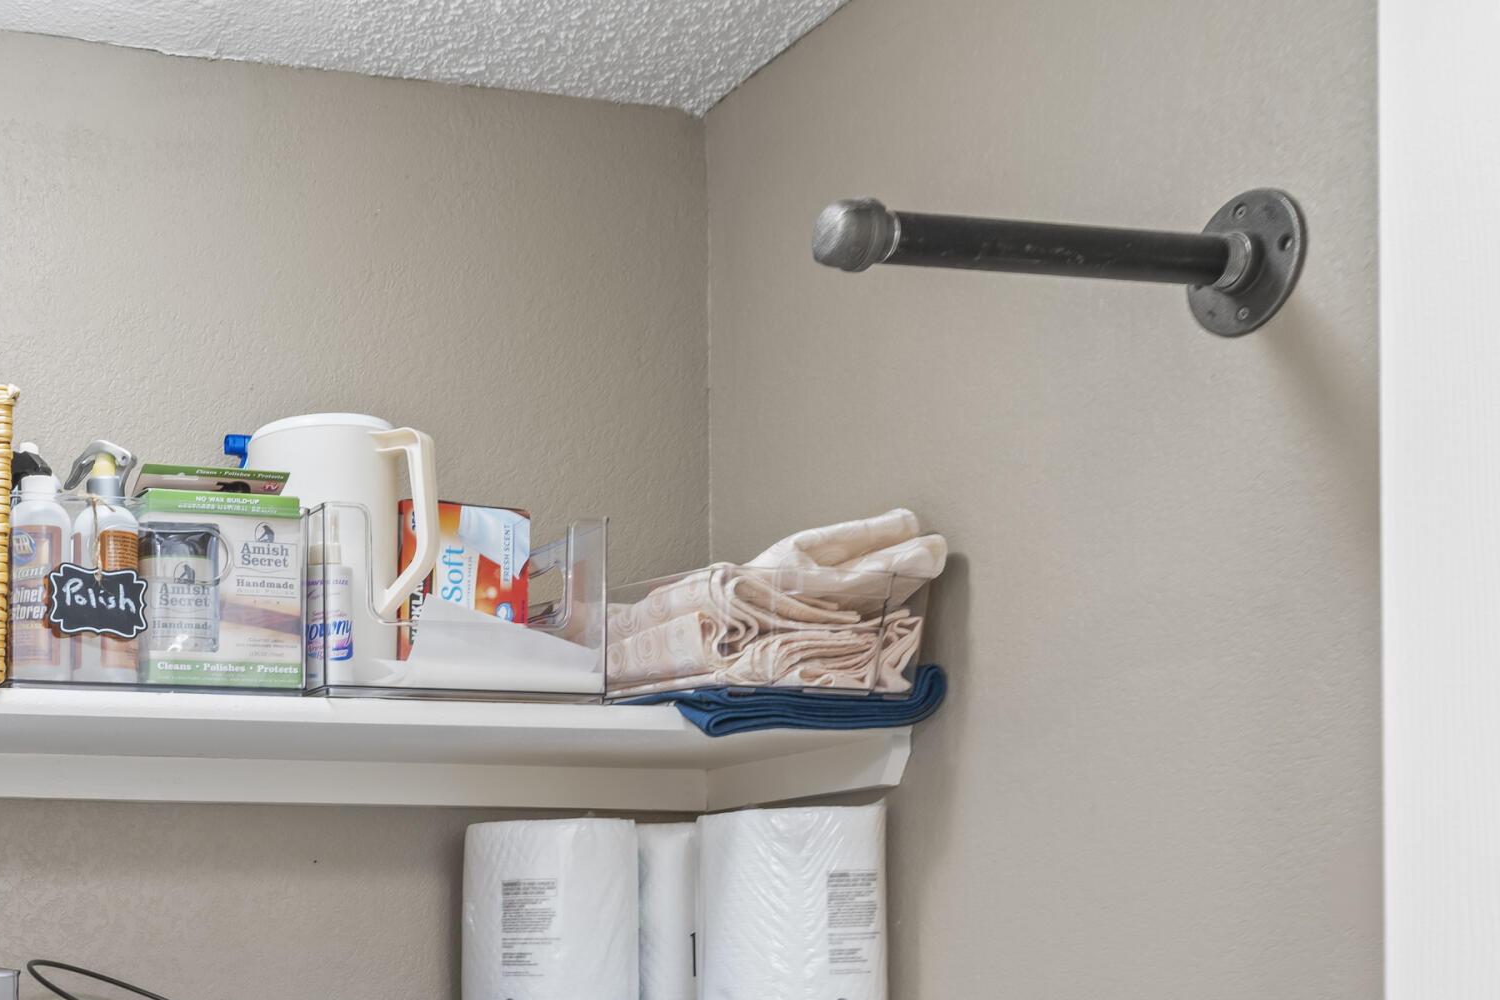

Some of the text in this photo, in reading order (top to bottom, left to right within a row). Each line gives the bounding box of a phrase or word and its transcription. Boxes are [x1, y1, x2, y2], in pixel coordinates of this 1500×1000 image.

[240, 542, 289, 556] Amish
[241, 554, 289, 567] Secret
[441, 545, 464, 603] Soft
[159, 583, 210, 595] Amish
[236, 579, 294, 590] Handmade
[13, 586, 44, 603] binet
[62, 578, 136, 613] Polish
[159, 595, 210, 607] Secret
[12, 604, 47, 620] torer
[306, 620, 352, 646] owny
[157, 661, 299, 674] Cleans Polishes Protects
